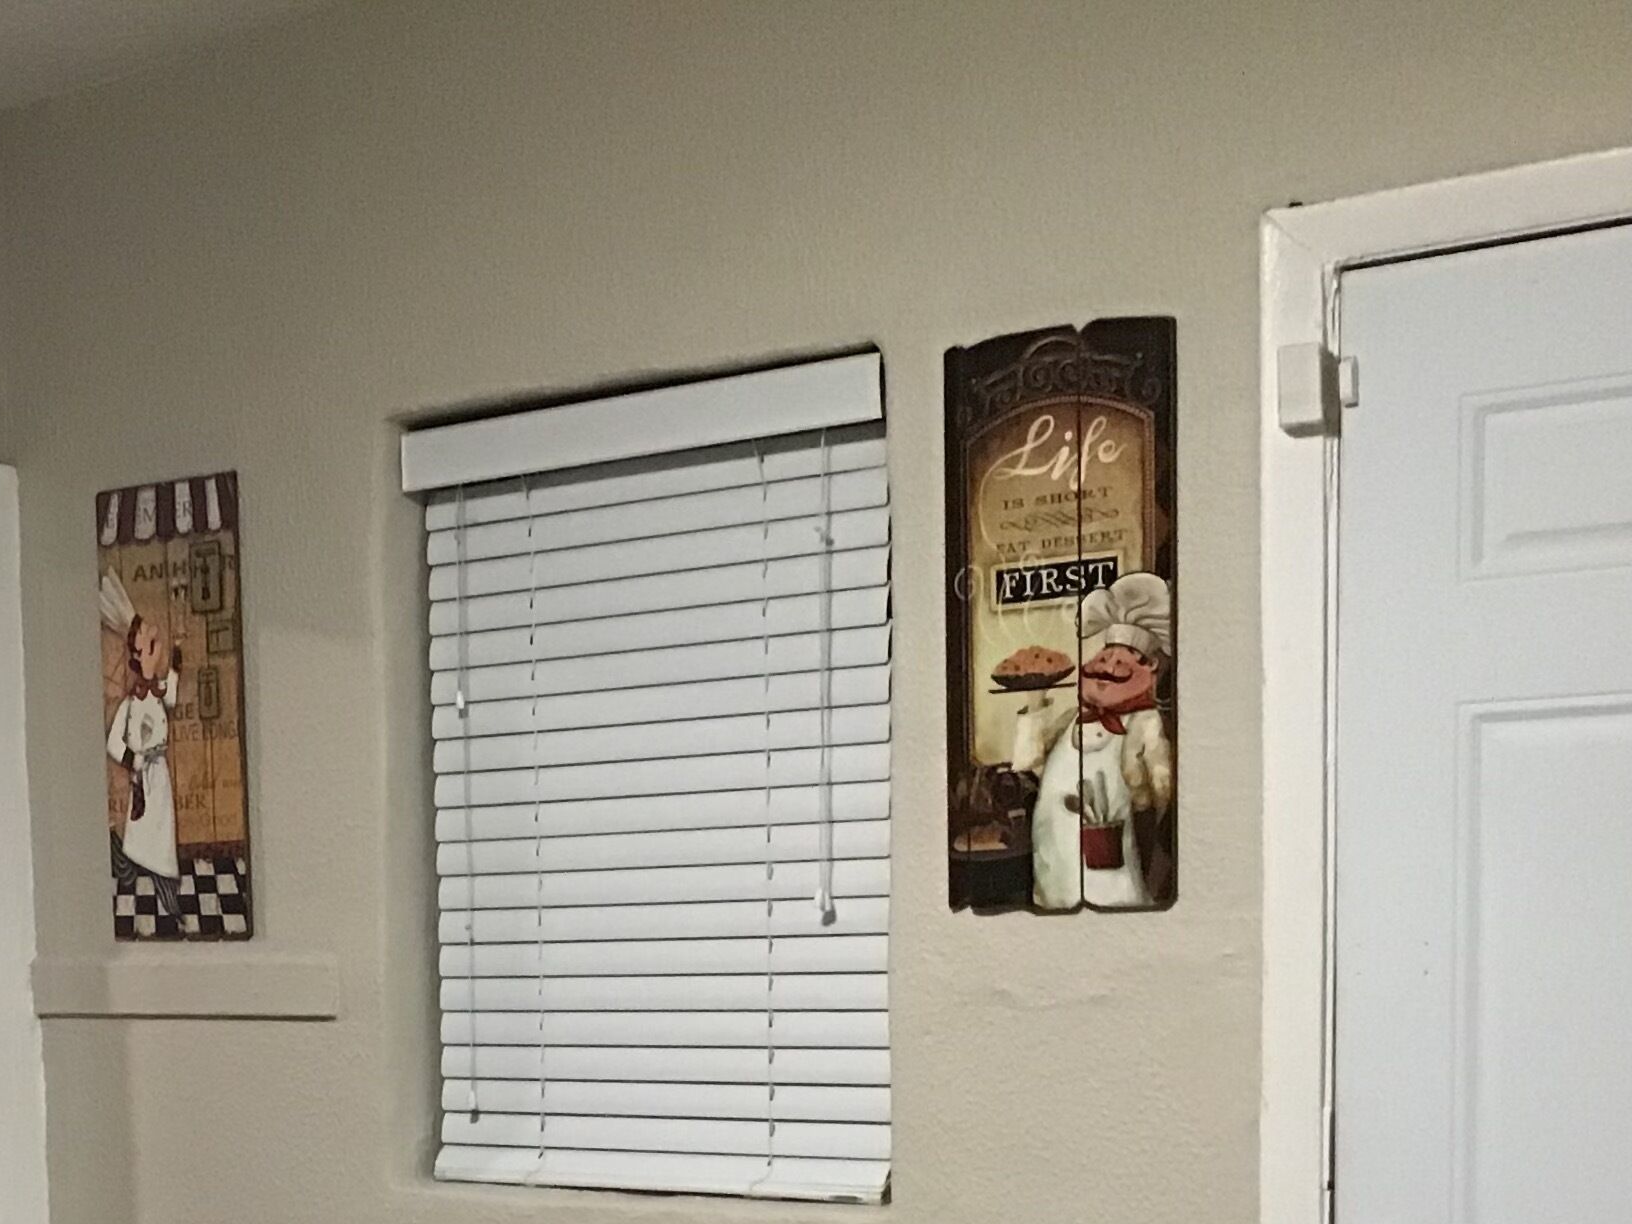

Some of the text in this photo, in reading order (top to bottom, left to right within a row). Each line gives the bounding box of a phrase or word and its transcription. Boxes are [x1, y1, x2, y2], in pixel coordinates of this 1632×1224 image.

[982, 414, 1128, 491] Life
[1036, 486, 1114, 505] SHORT
[1003, 561, 1114, 599] FIRST
